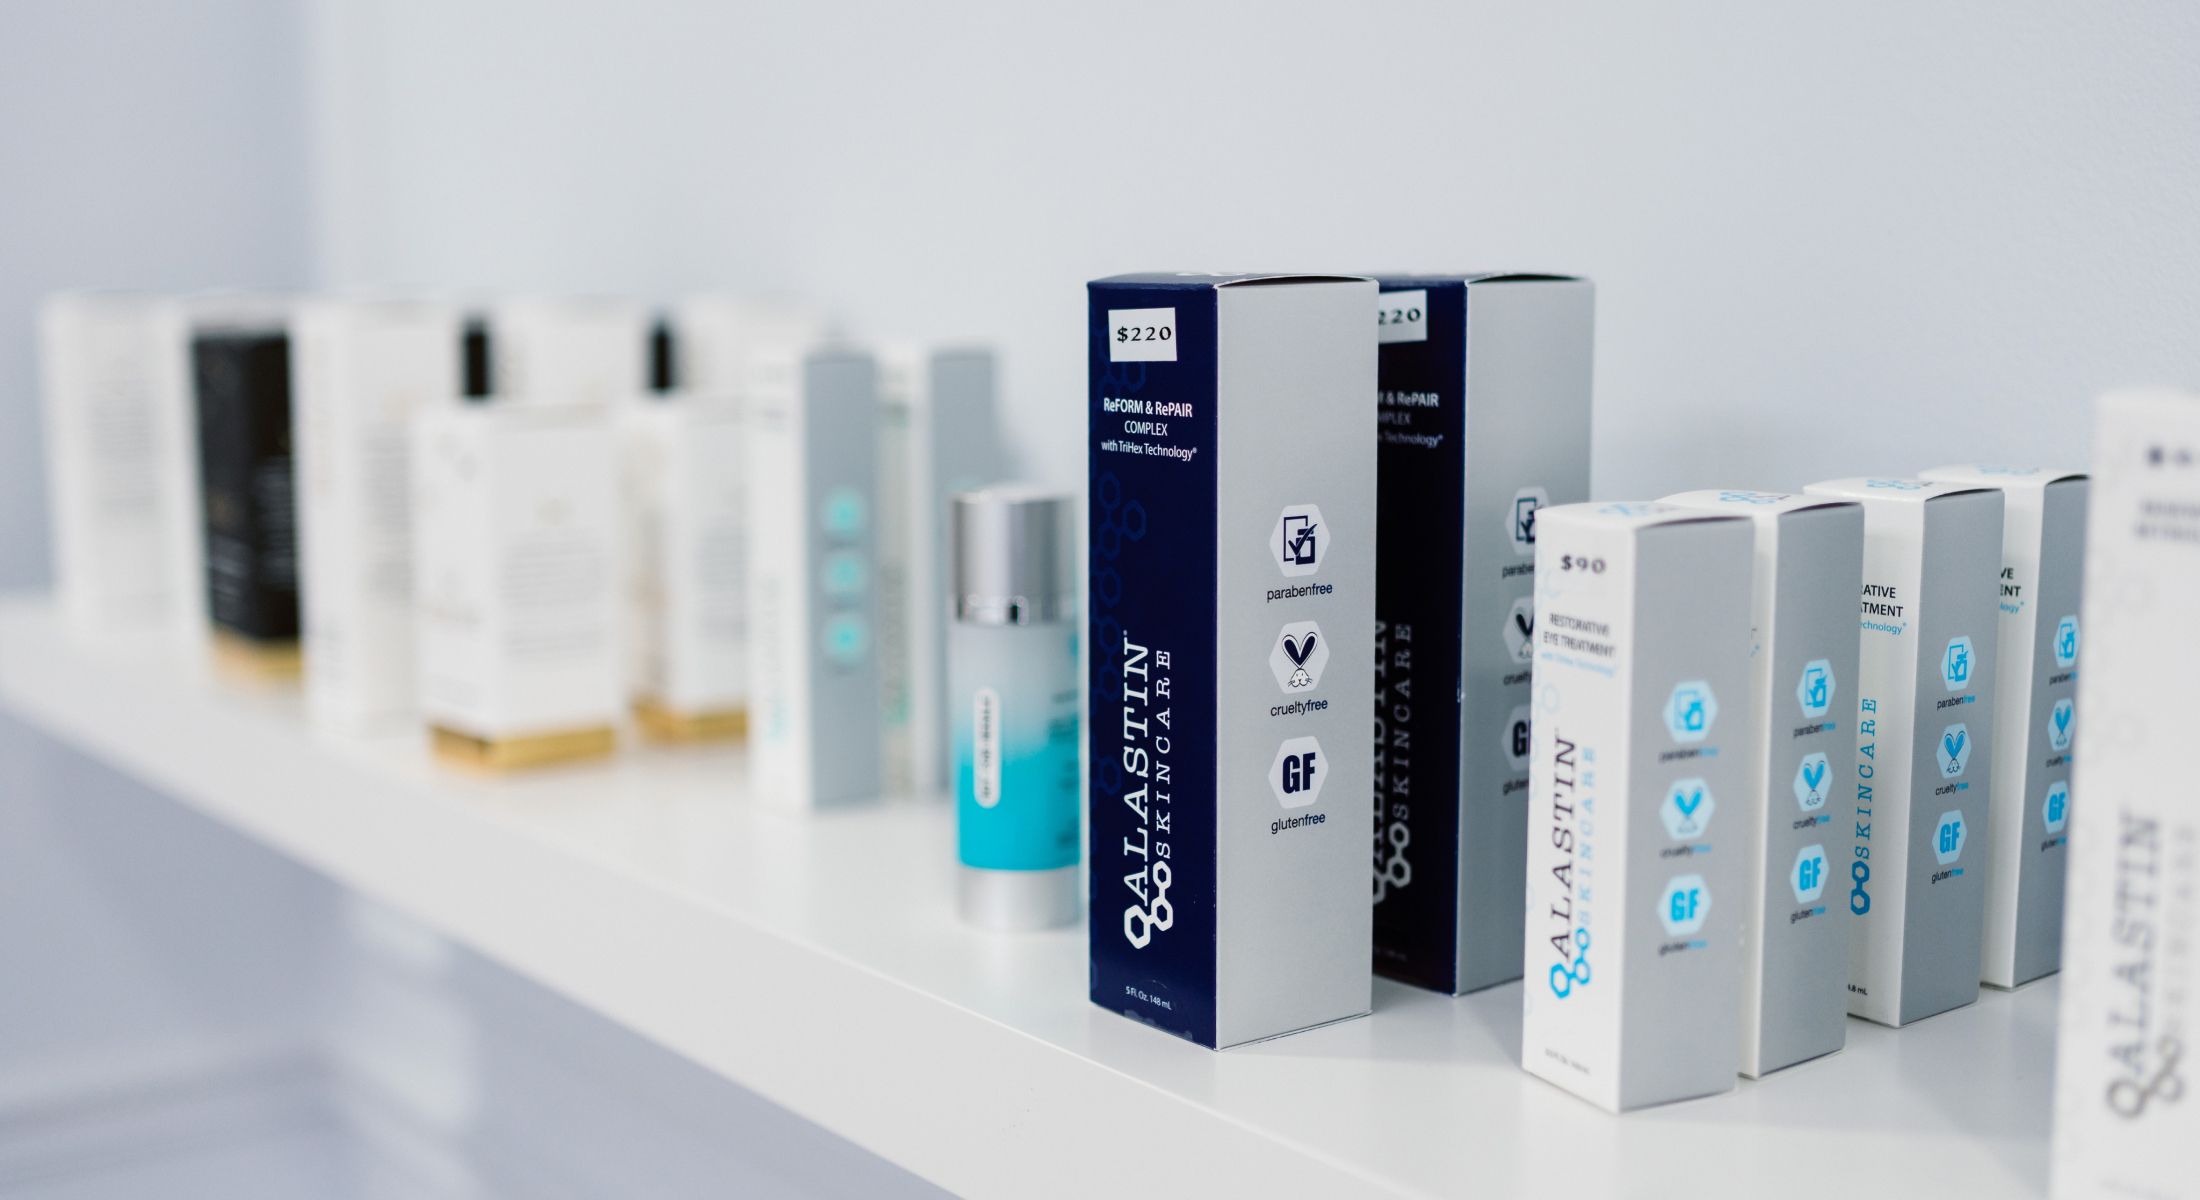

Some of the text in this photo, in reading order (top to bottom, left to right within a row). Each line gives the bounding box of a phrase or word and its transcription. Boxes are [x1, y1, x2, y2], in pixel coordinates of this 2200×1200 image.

[1378, 308, 1421, 325] 220
[1117, 326, 1172, 343] $220
[1103, 397, 1193, 418] ReFORM & RePAIR
[1397, 391, 1440, 408] RePAIR
[1378, 410, 1412, 425] PLEX
[1124, 420, 1168, 436] COMPLEX
[1101, 440, 1118, 452] with
[1118, 441, 1143, 455] TriHex
[1561, 554, 1607, 574] $90
[1267, 582, 1333, 603] parabenfree
[1861, 584, 1897, 599] ATIVE
[1861, 601, 1904, 618] TMENT
[1270, 699, 1328, 717] crueltyfree
[1393, 623, 1411, 820] SKINCARE
[1156, 650, 1172, 860] SKINCARE
[1282, 752, 1316, 794] GF
[1854, 697, 1877, 862] SKINCARE
[1271, 813, 1326, 835] glutenfree
[1939, 821, 1961, 854] GF
[1798, 856, 1822, 891] GF
[1670, 887, 1700, 922] GF
[1150, 994, 1160, 1006] 148
